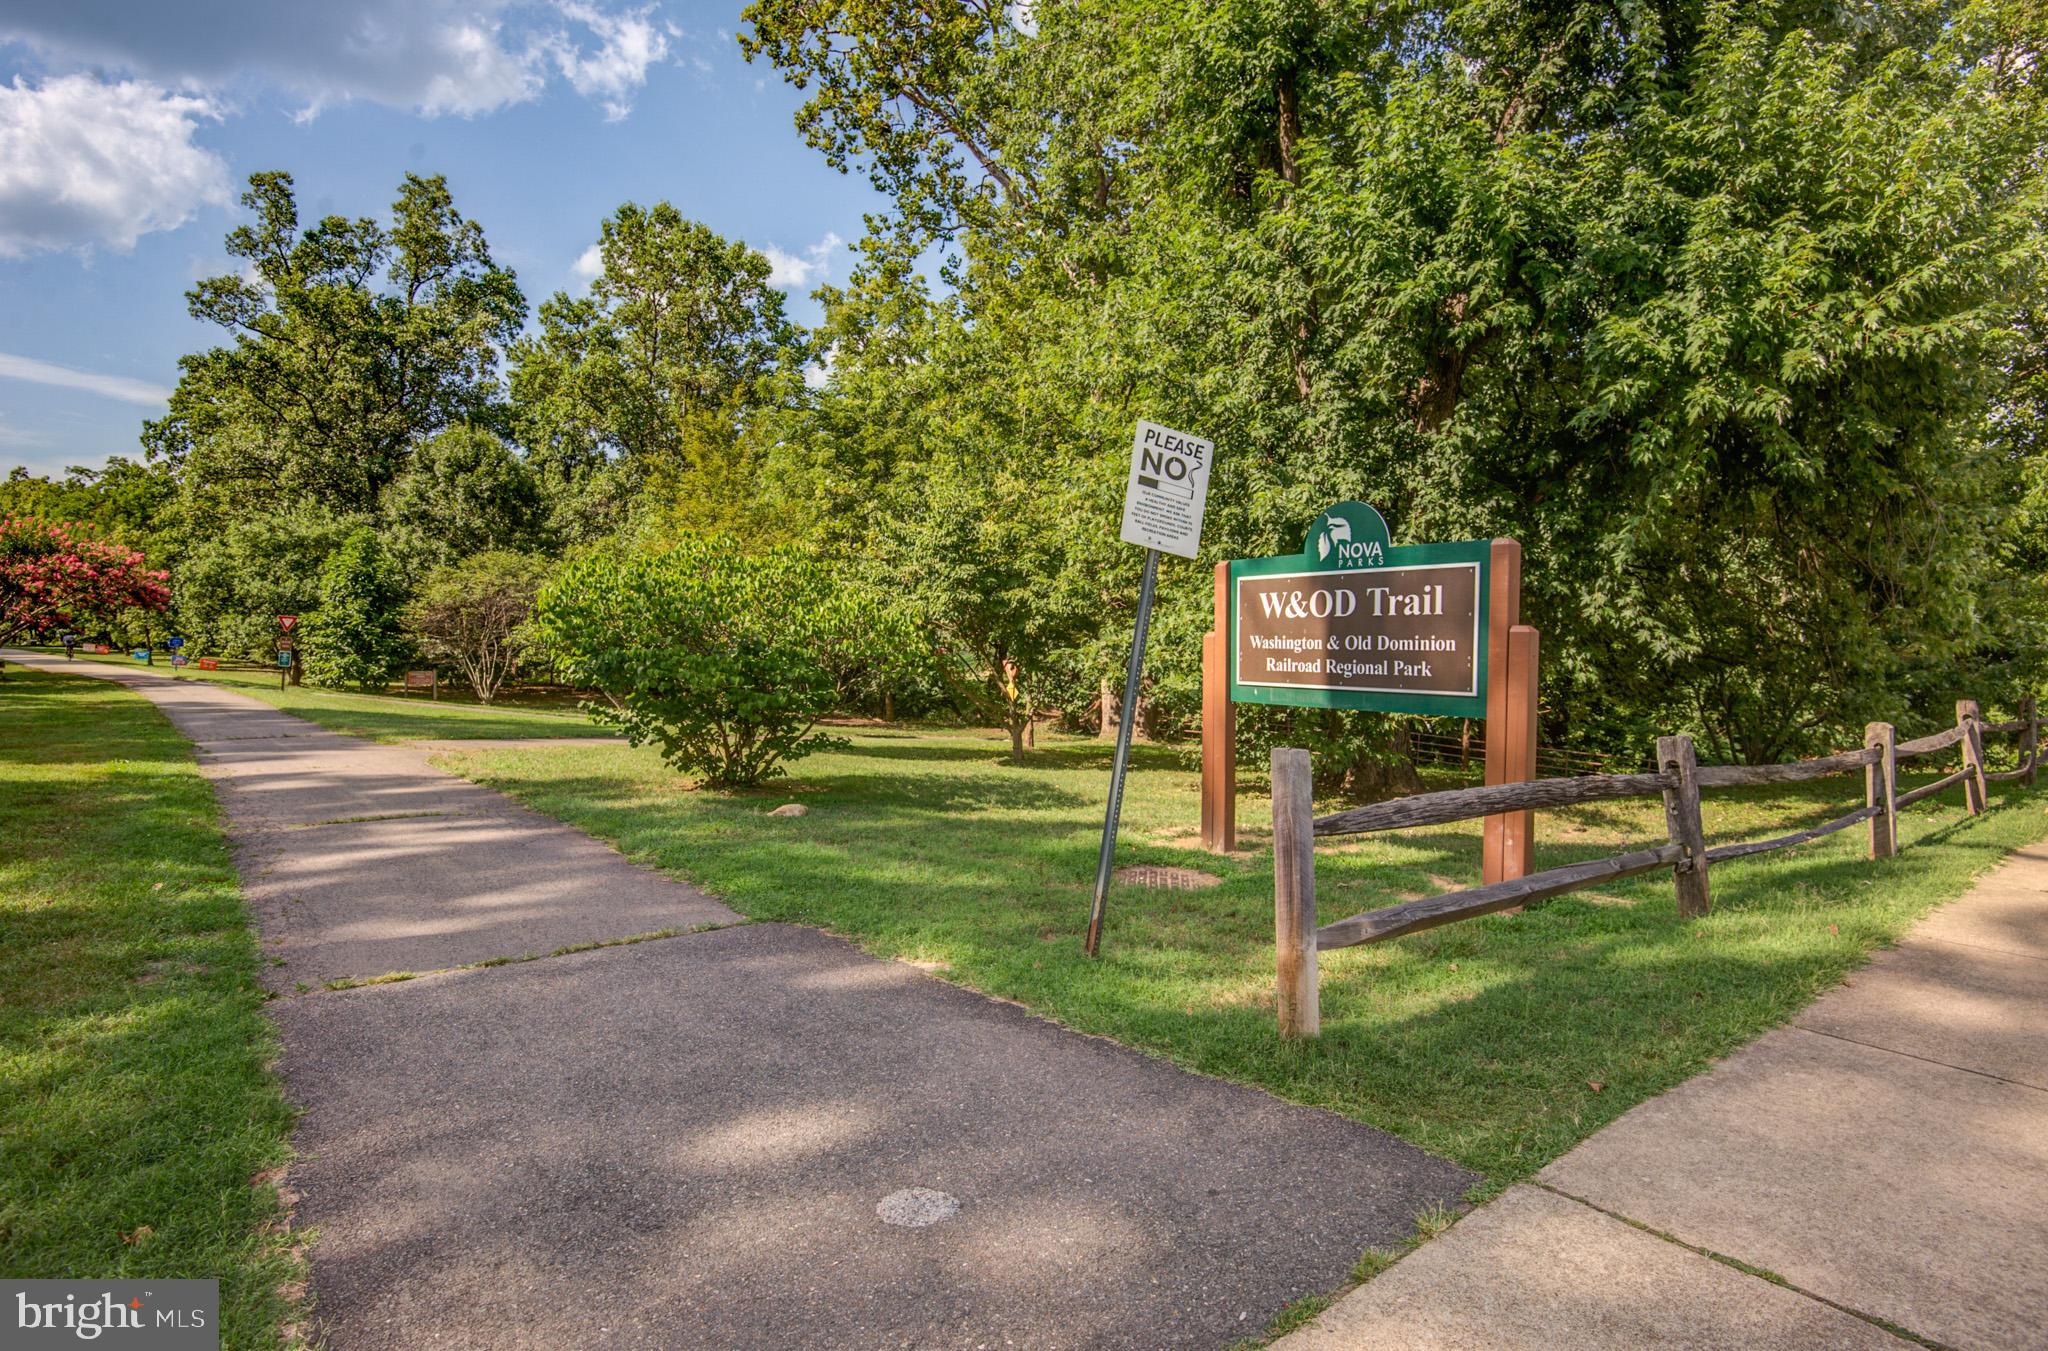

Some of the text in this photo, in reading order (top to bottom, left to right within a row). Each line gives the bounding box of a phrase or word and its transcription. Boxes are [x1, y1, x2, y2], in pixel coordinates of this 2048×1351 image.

[1144, 429, 1205, 460] PLEASE
[1141, 447, 1187, 481] NO
[1338, 541, 1382, 559] NOVA
[1338, 556, 1384, 568] PARKS
[1259, 585, 1444, 619] W&OD Trail
[1250, 634, 1456, 654] Washington & Old Dominion
[1266, 657, 1432, 678] Railroad Regional Park
